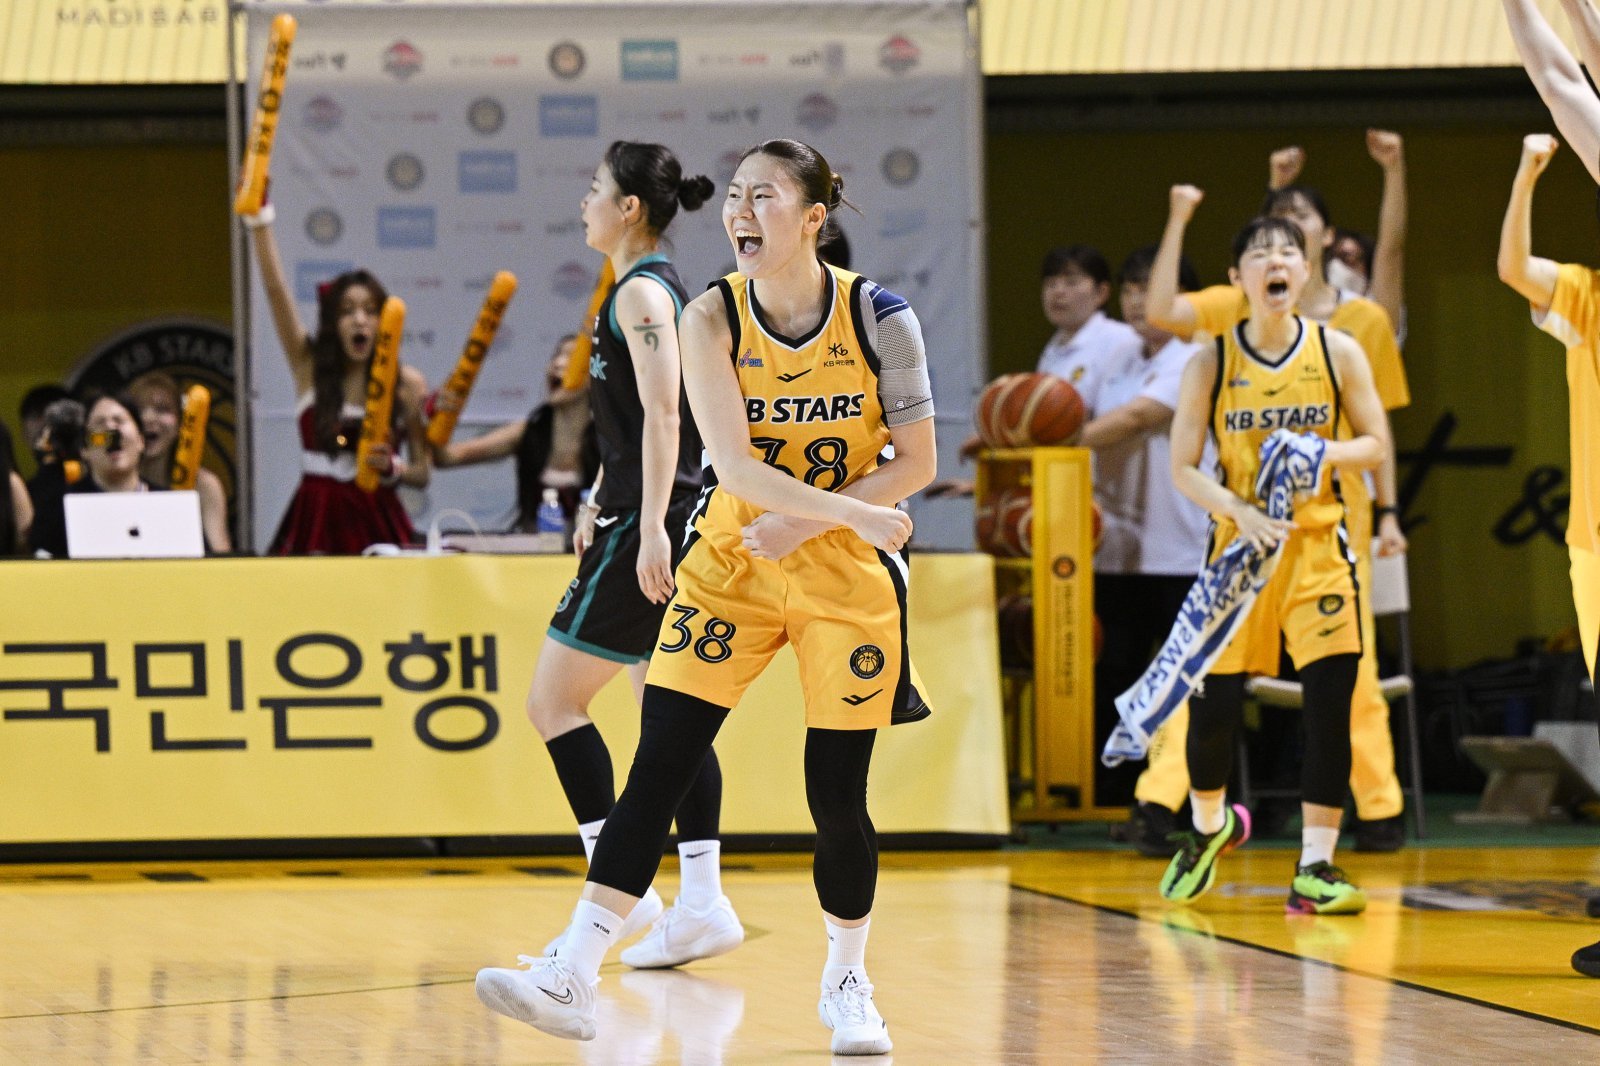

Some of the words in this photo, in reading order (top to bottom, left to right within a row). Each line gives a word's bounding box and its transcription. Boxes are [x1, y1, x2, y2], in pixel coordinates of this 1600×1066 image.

[743, 397, 766, 423] B
[771, 393, 865, 423] STARS
[1225, 411, 1253, 431] KB
[1259, 404, 1329, 429] STARS
[659, 604, 737, 663] 38
[0, 632, 500, 754] 국민은행
